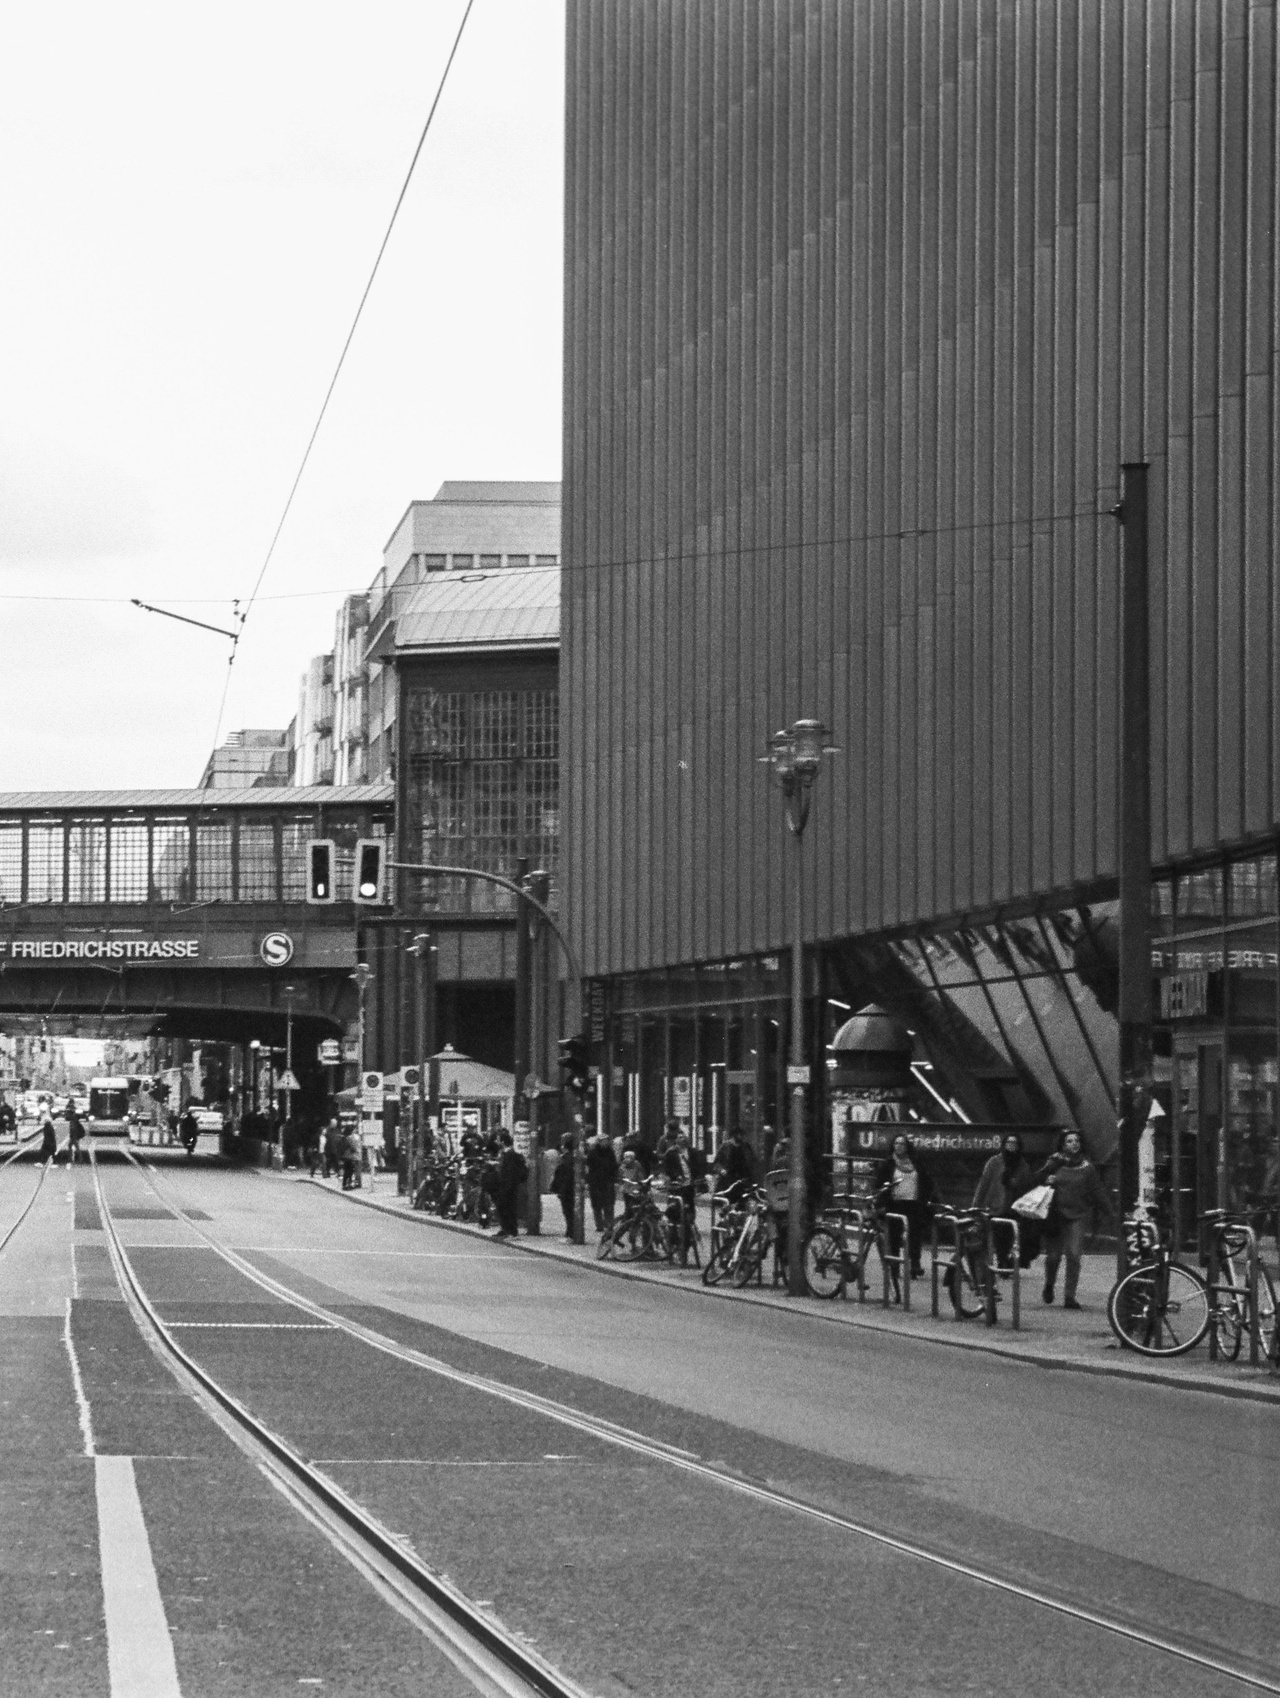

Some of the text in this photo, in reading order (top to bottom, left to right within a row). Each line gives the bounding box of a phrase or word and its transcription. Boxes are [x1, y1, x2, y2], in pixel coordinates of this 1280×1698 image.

[11, 940, 199, 958] FRIEDRICHSTRASSE
[265, 934, 289, 965] S
[859, 1131, 1001, 1150] U Friedrichstraß
